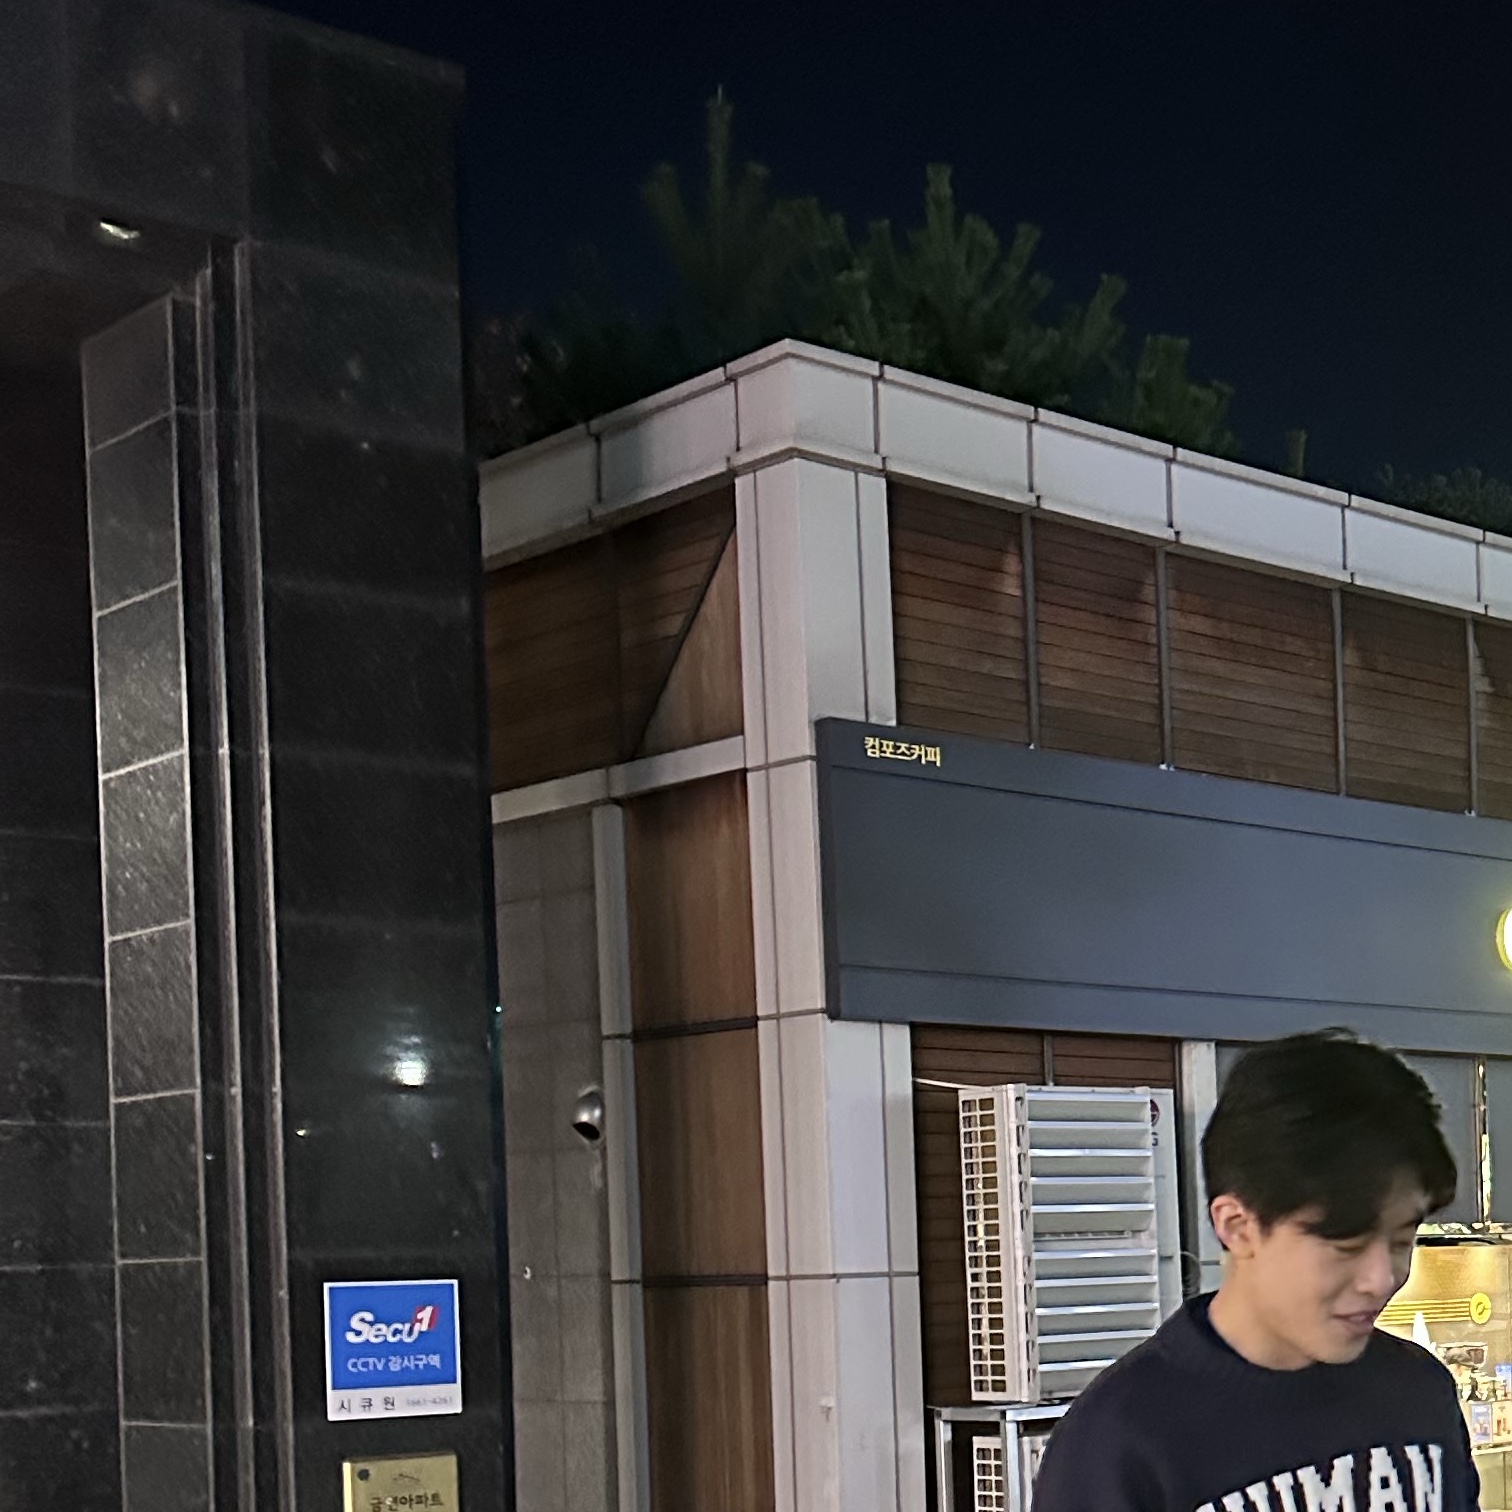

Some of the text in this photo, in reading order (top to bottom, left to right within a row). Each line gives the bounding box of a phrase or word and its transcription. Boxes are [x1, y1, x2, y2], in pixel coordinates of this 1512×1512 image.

[864, 736, 941, 767] 컴포즈커피
[347, 1353, 442, 1373] CCTV 감시구역
